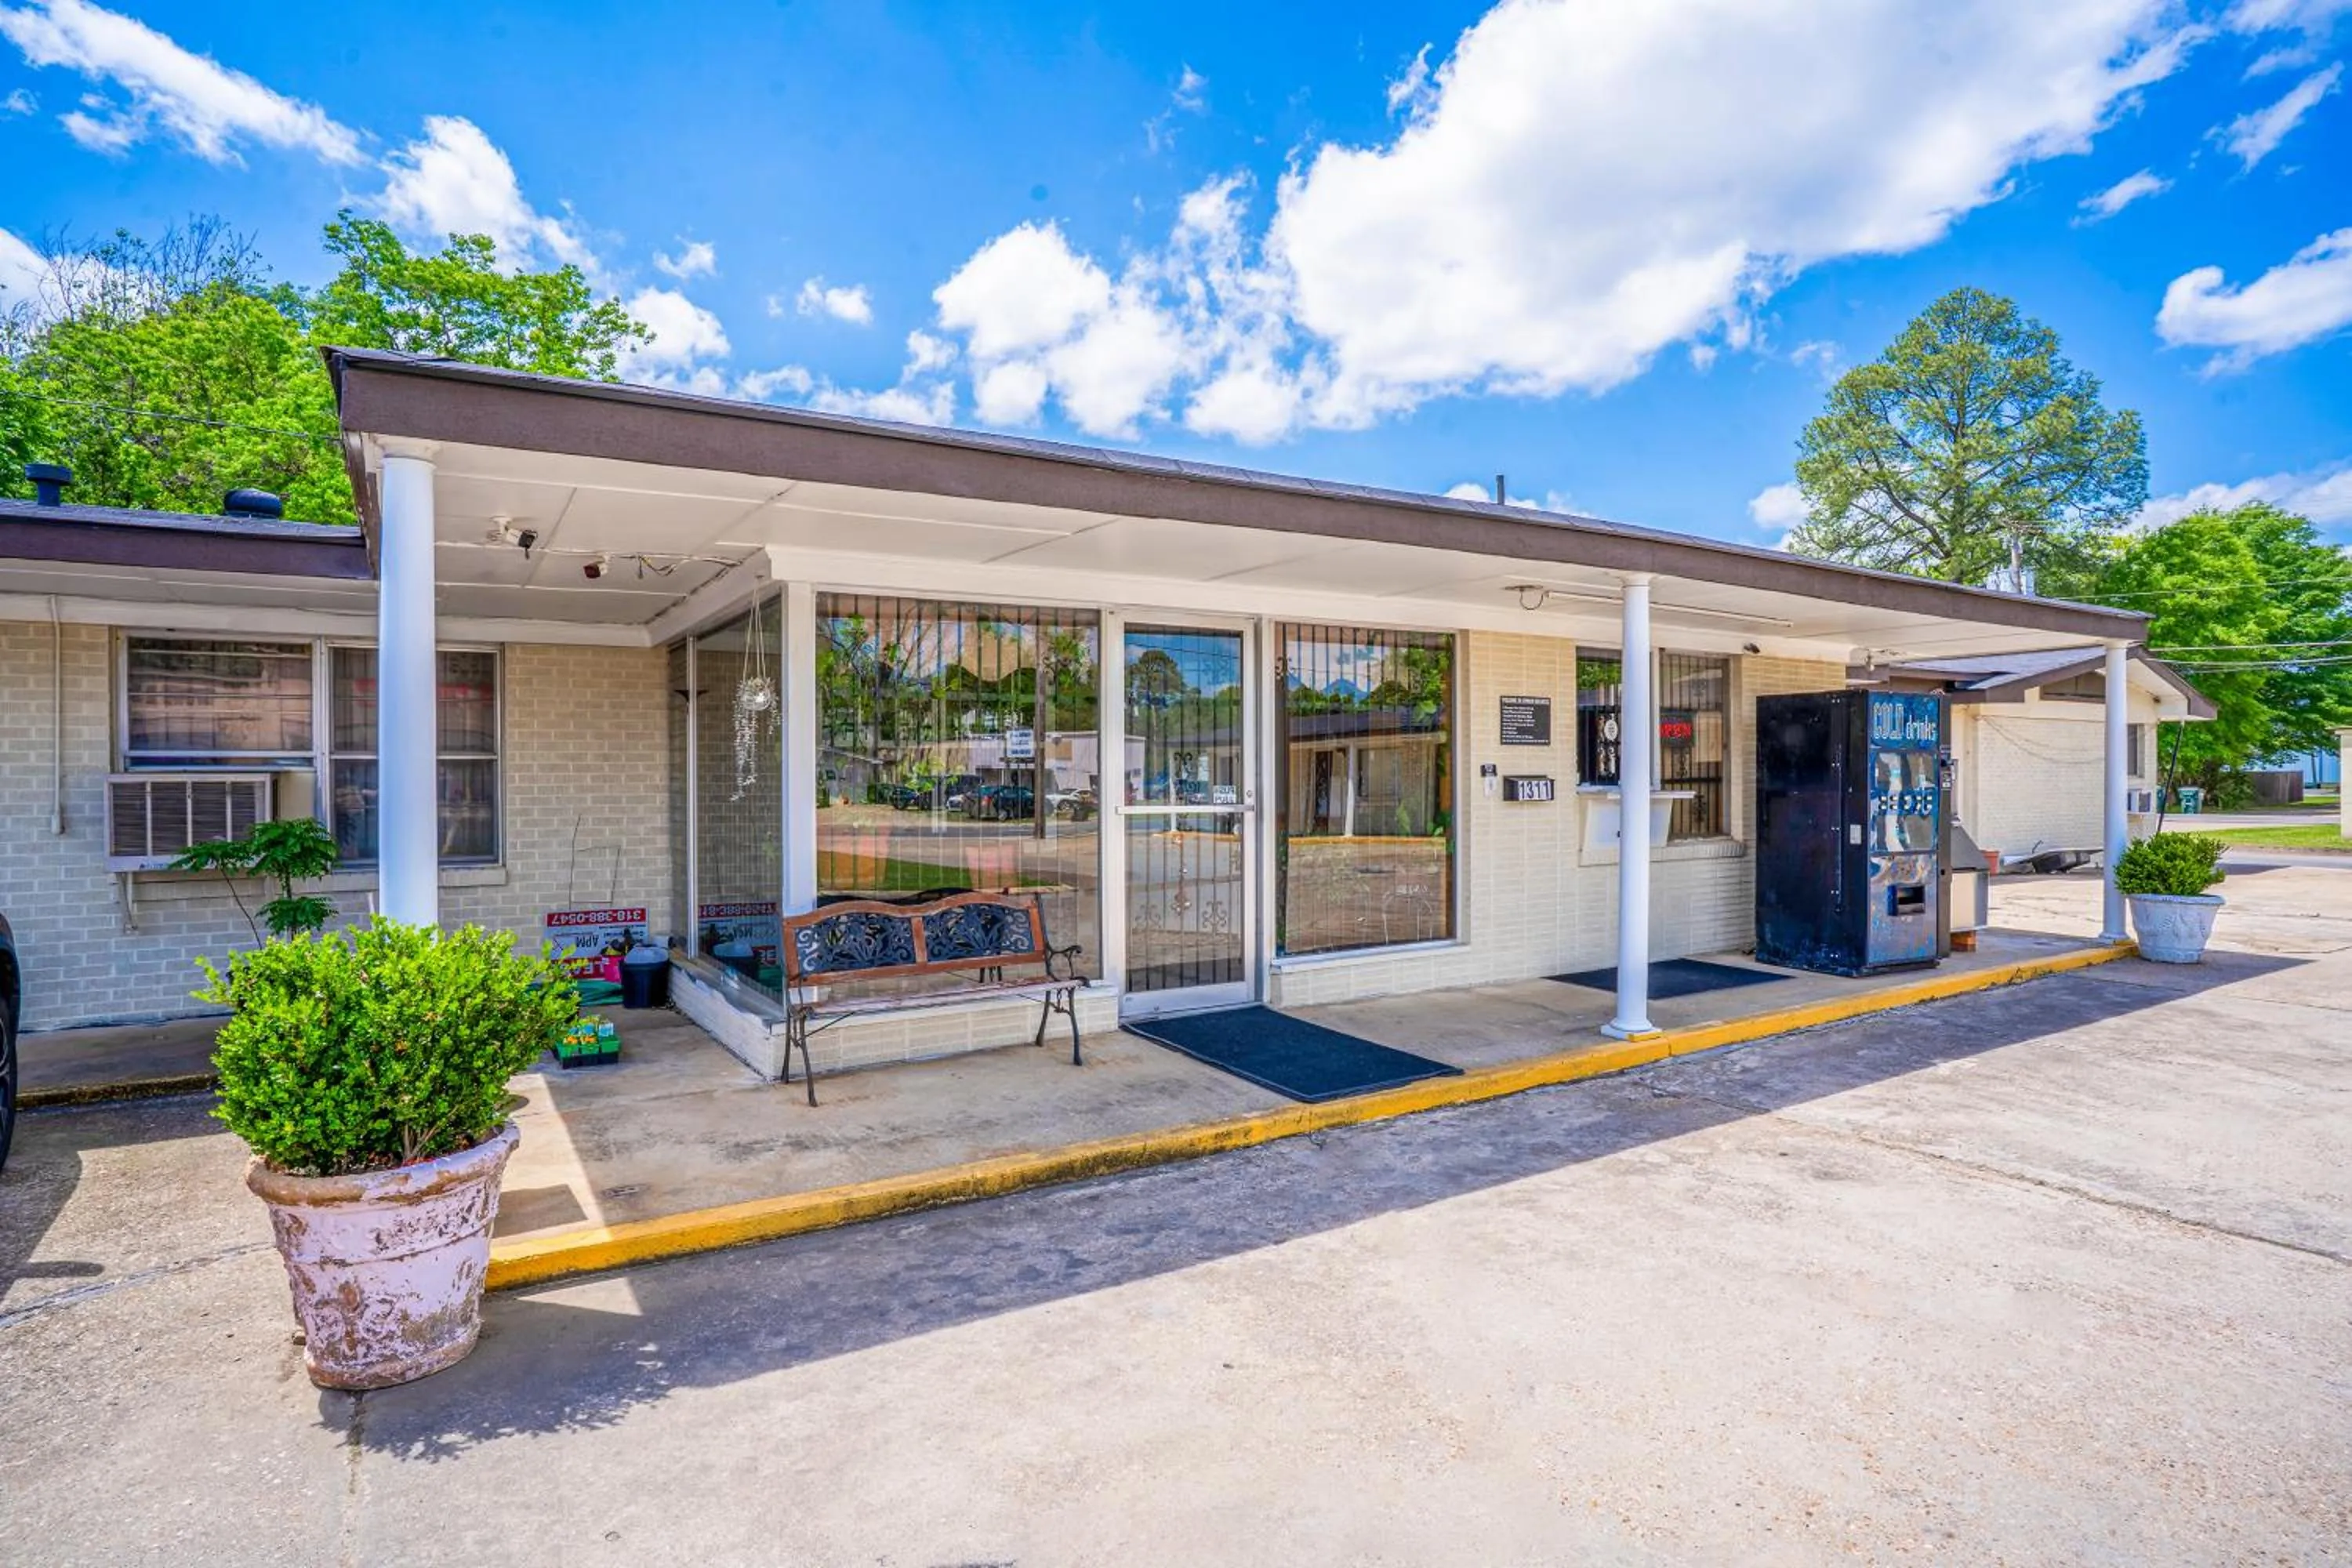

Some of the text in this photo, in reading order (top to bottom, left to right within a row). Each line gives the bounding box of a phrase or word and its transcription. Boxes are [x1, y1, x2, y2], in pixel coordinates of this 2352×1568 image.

[1872, 702, 1937, 741] COLD drinks
[1520, 782, 1550, 799] 1311
[576, 935, 599, 948] APM
